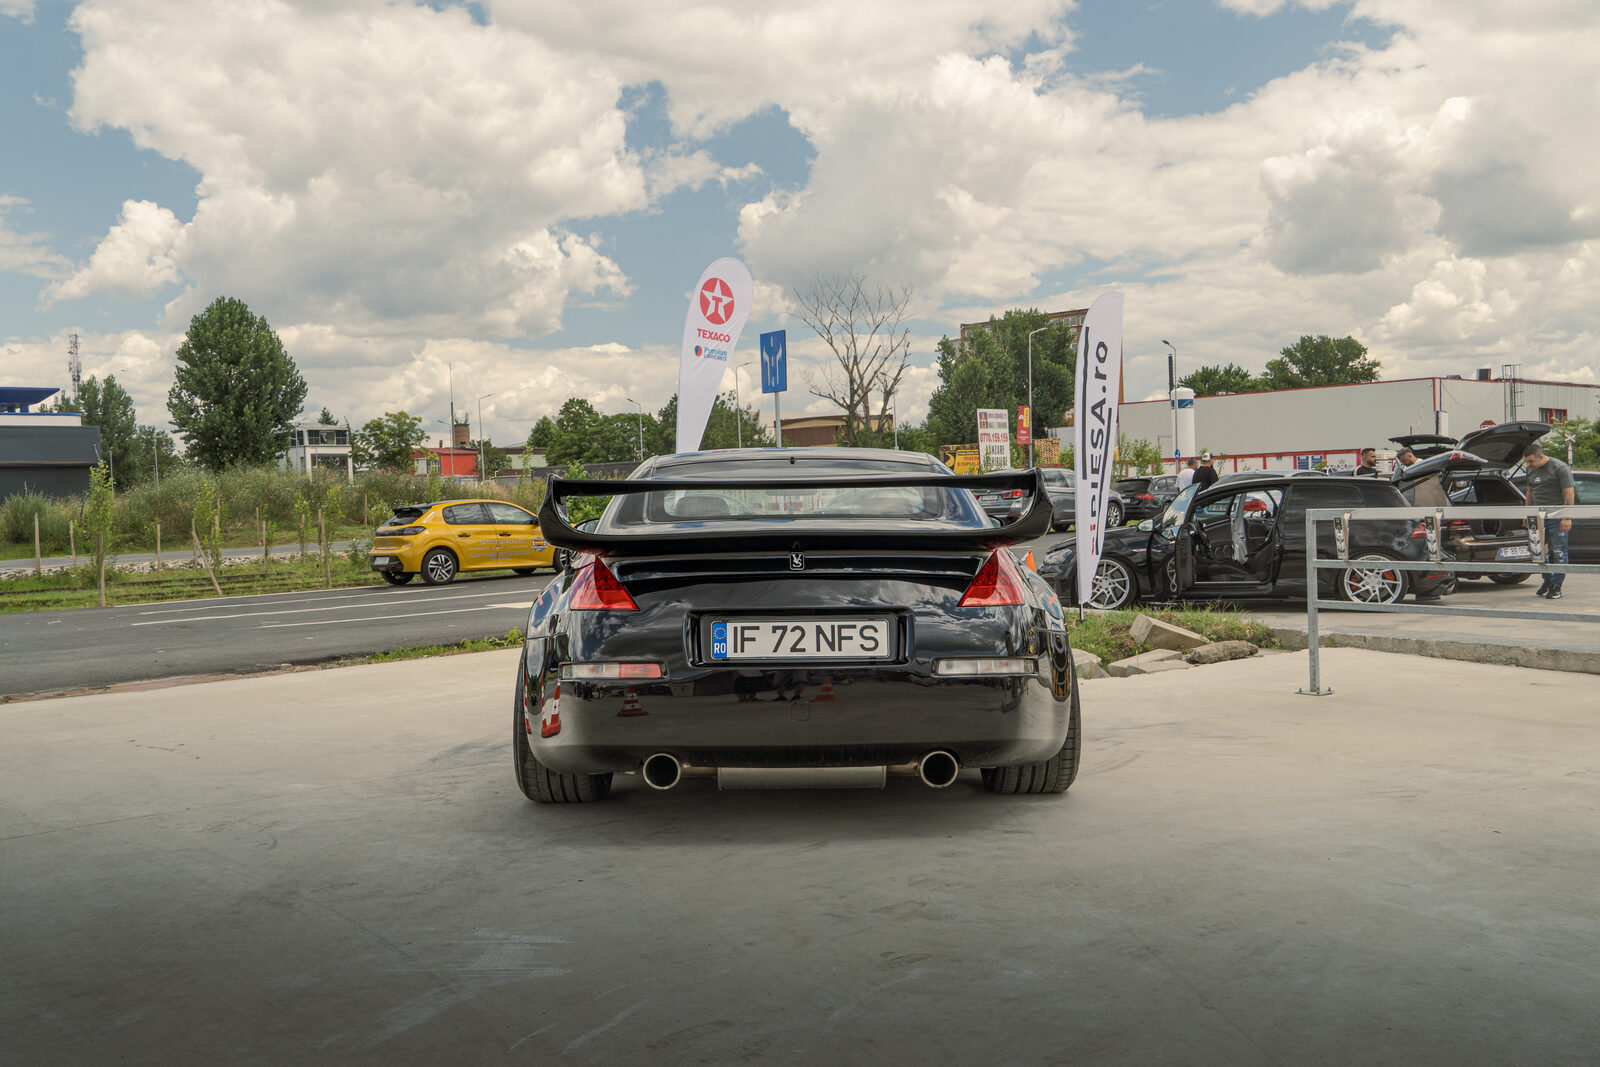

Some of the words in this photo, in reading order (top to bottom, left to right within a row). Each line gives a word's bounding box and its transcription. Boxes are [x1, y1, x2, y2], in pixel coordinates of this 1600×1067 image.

[697, 328, 731, 343] TEXACO
[733, 625, 760, 653] IF
[771, 625, 806, 653] 72
[815, 624, 879, 652] NFS
[714, 642, 726, 654] RO
